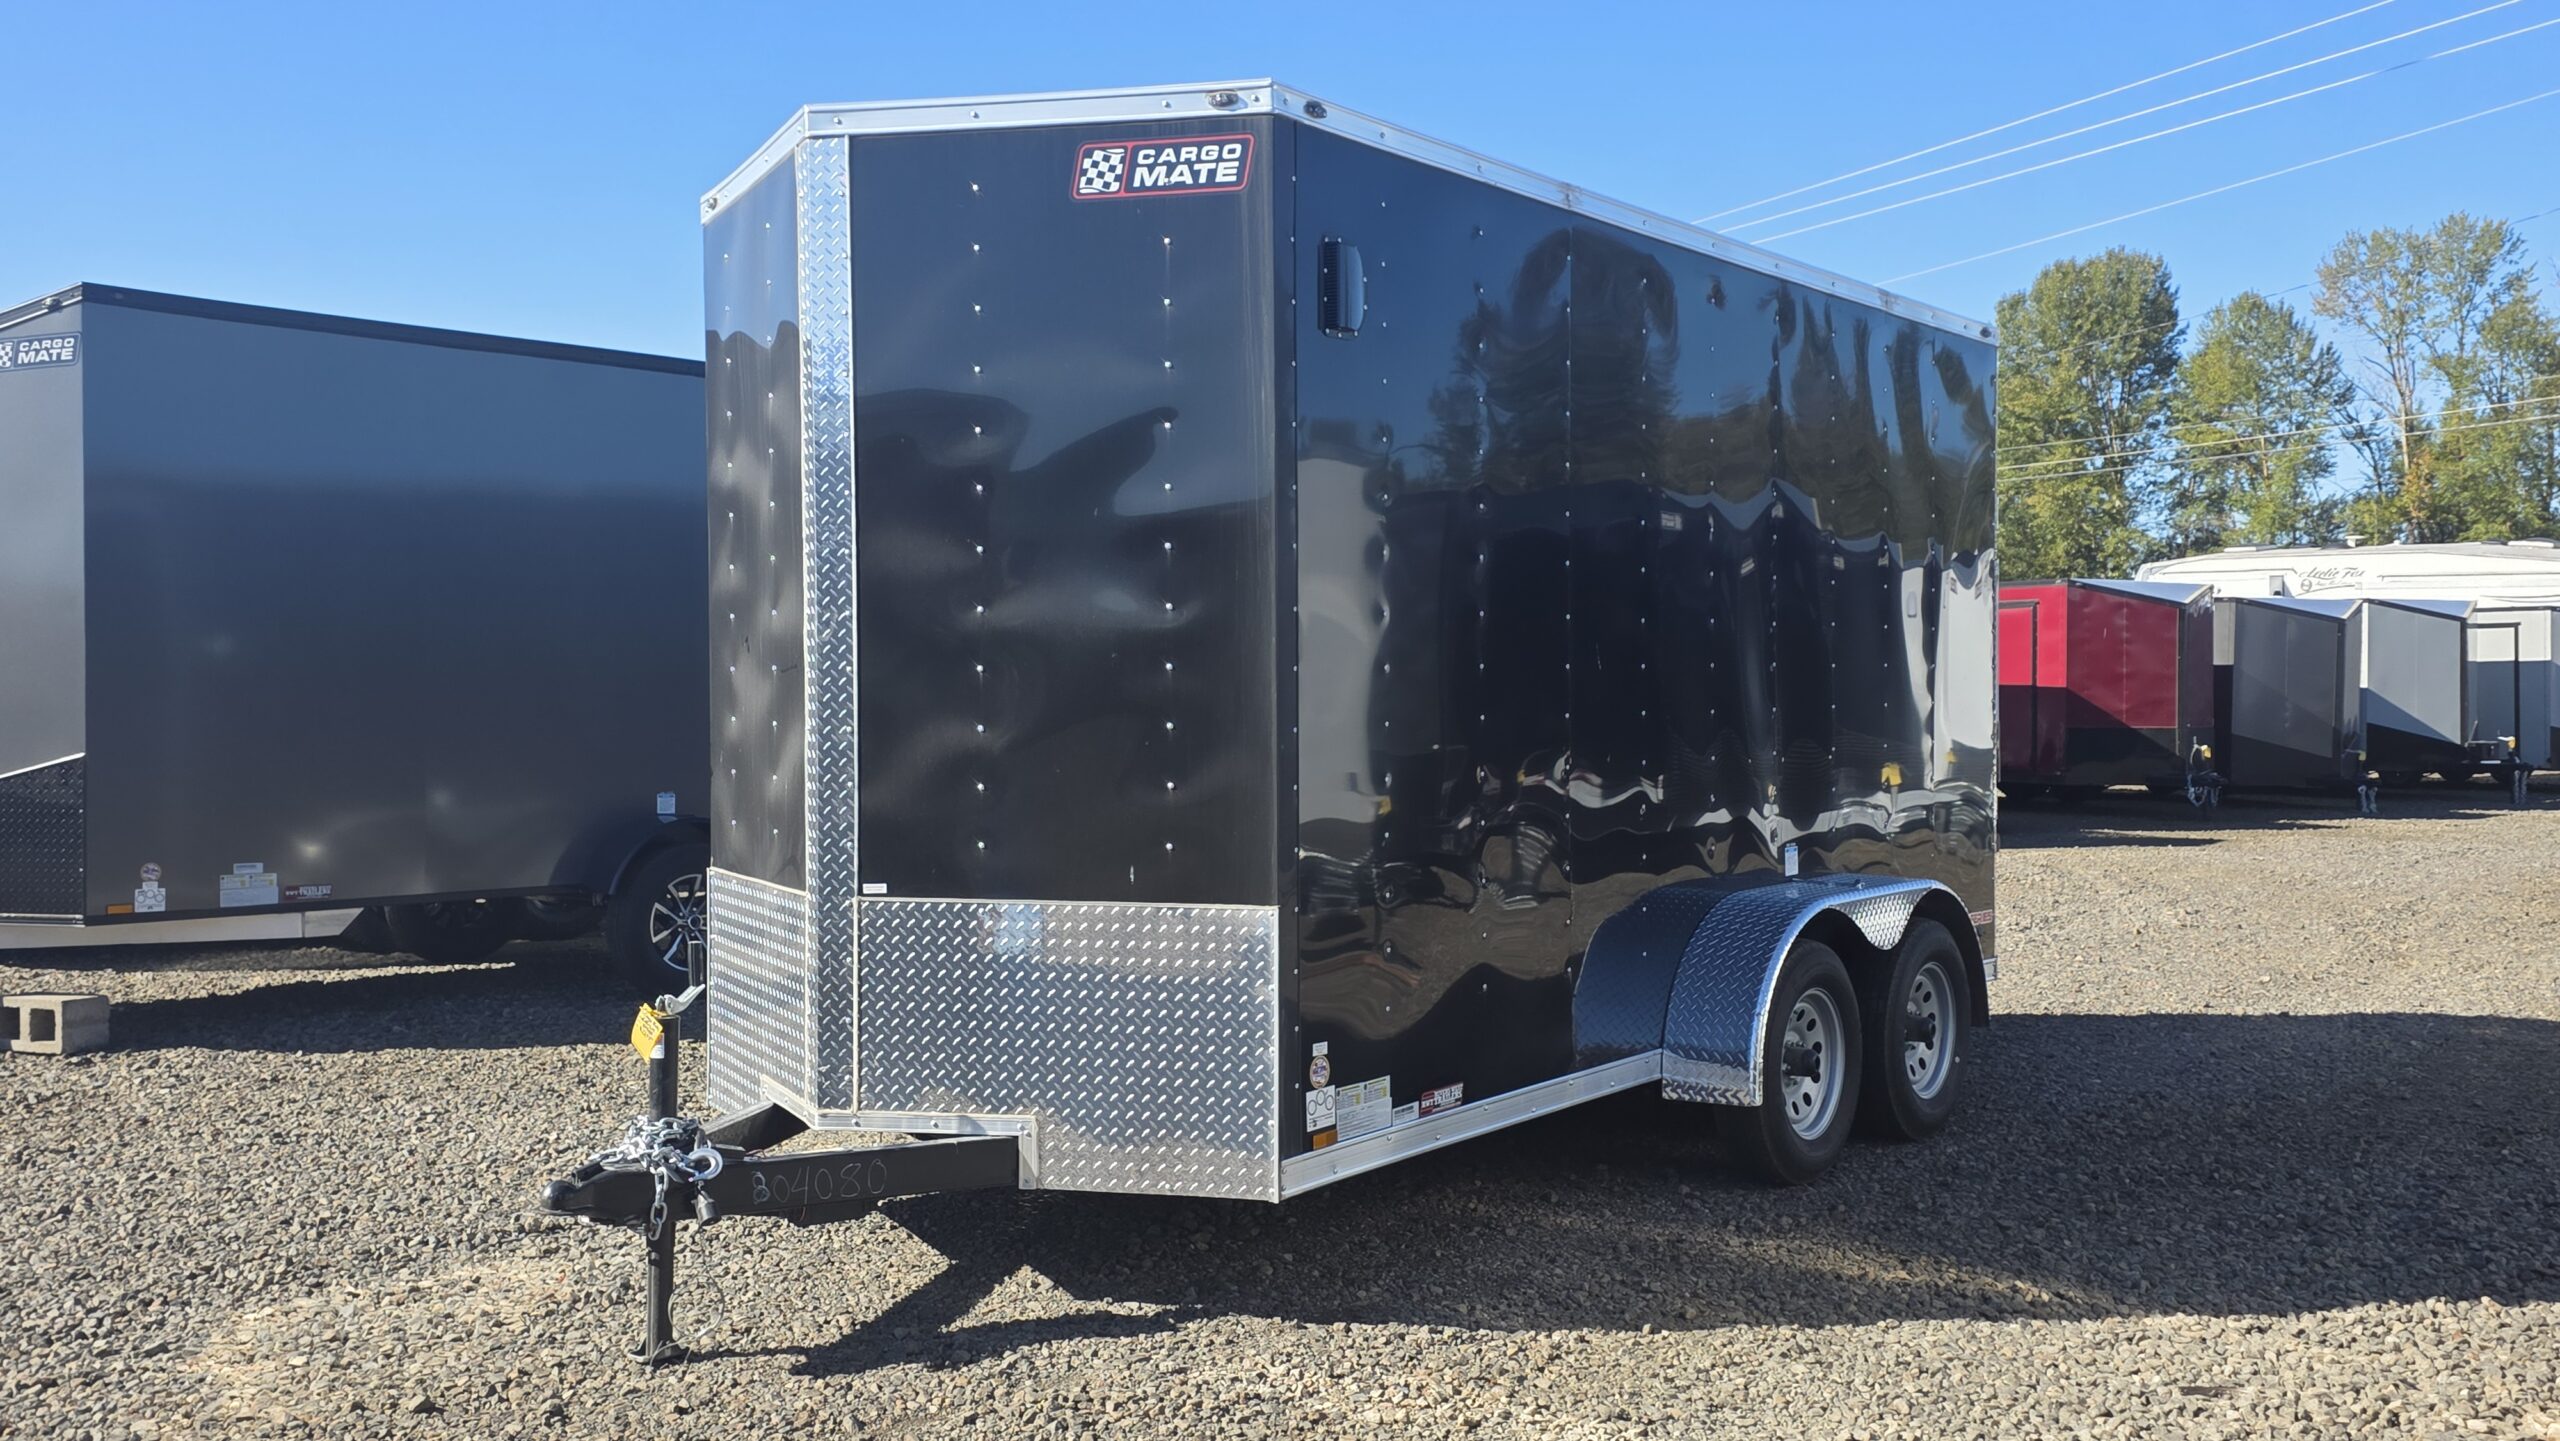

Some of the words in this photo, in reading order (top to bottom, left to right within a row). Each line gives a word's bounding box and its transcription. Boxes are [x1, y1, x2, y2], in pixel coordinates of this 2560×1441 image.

[1137, 143, 1242, 165] CARGO
[1133, 161, 1240, 187] MATE
[19, 337, 75, 351] CARGO
[17, 347, 74, 364] MATE
